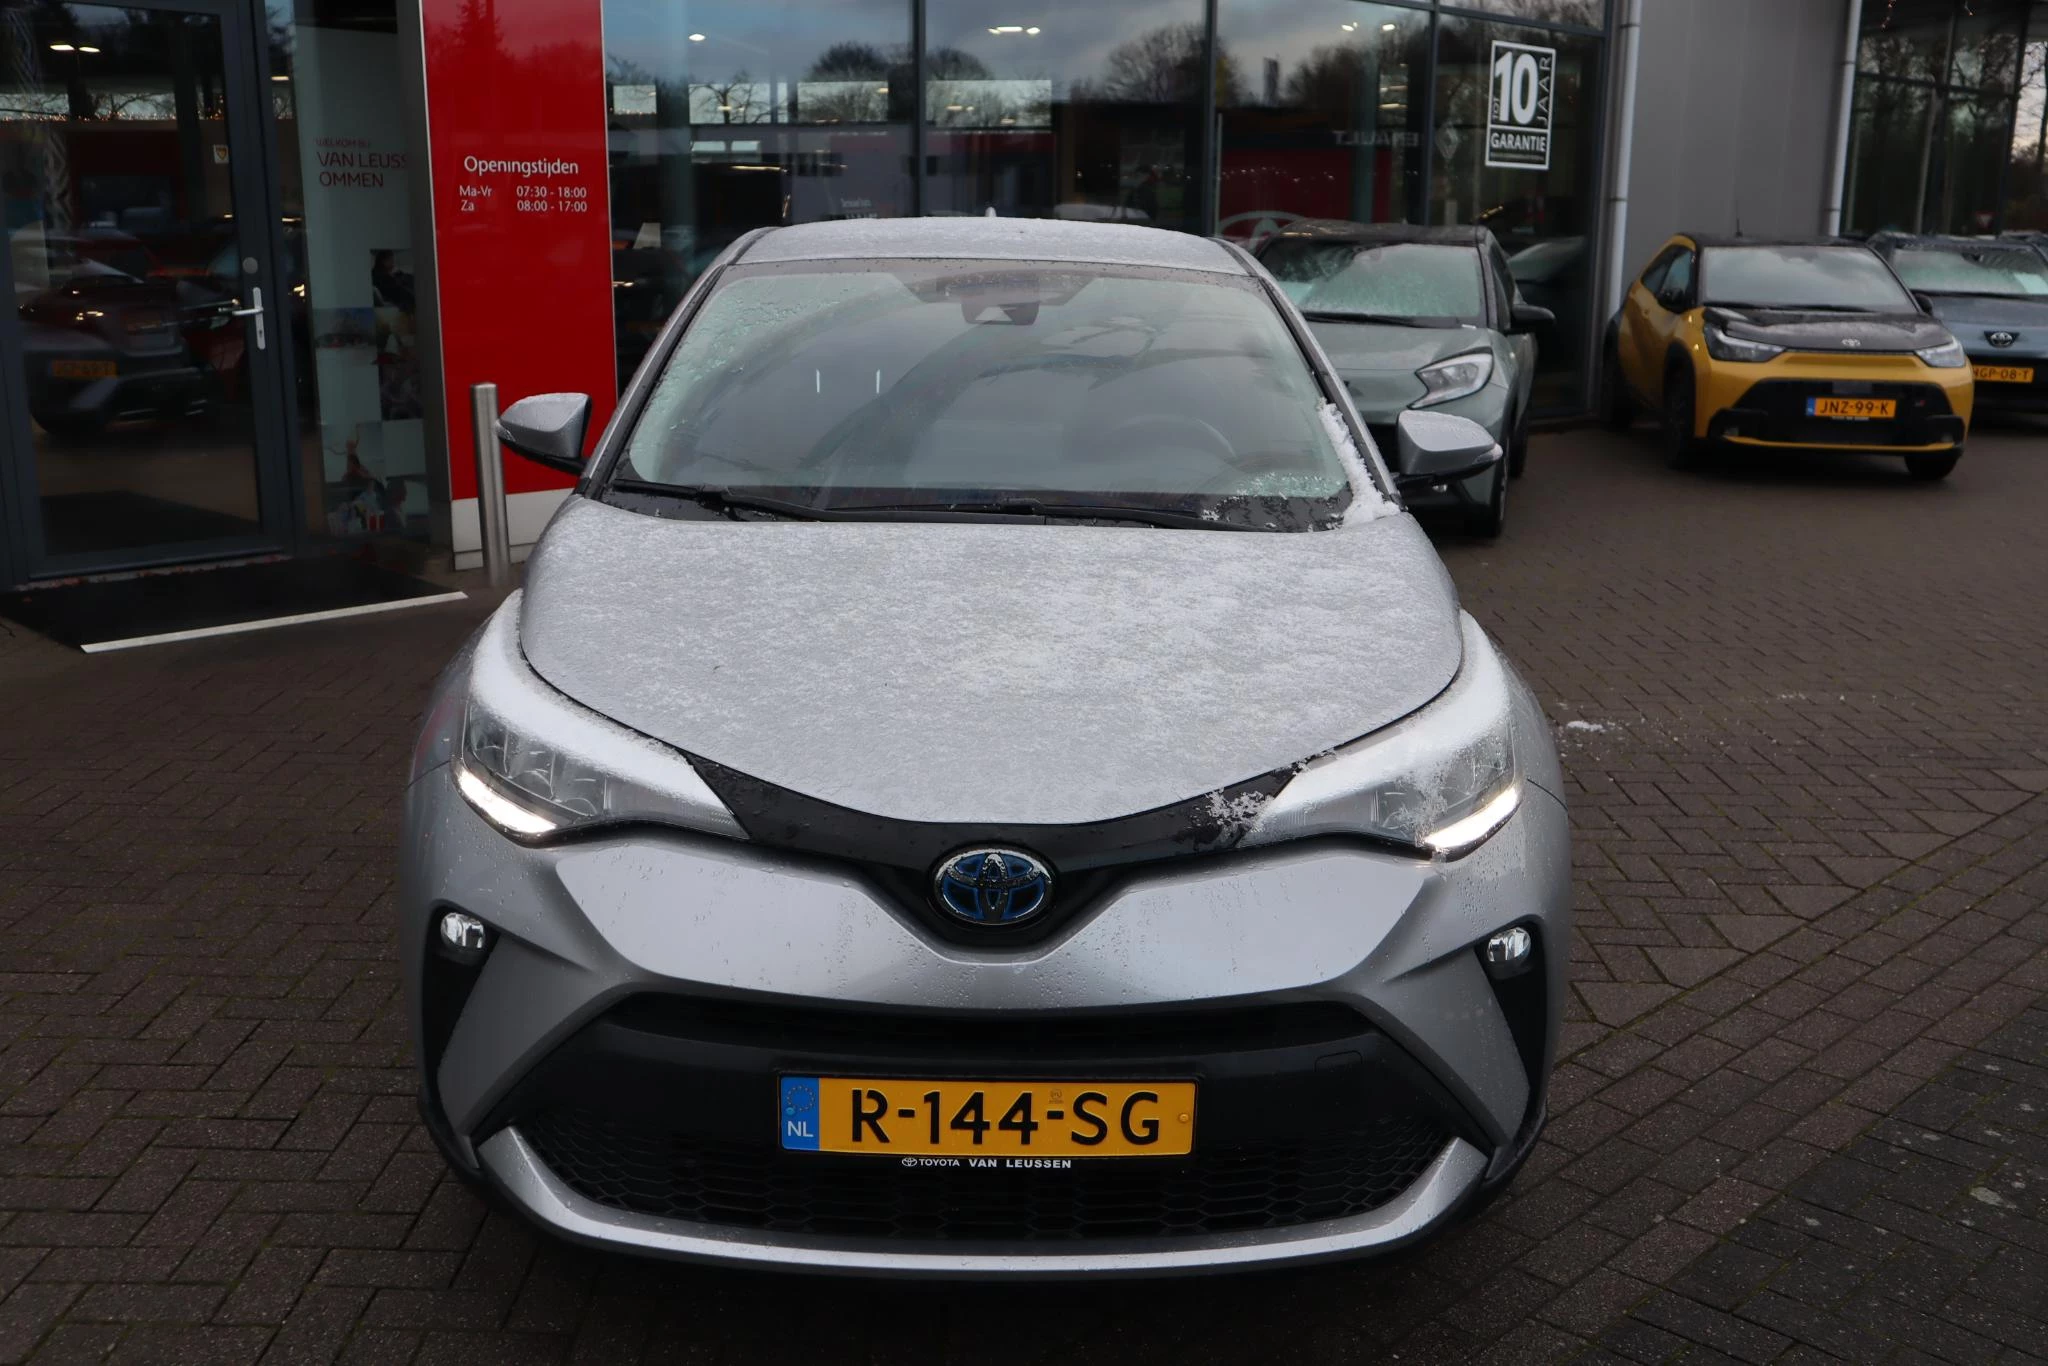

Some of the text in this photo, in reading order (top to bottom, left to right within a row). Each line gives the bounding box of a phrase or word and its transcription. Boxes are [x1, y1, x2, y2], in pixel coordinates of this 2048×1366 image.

[1494, 51, 1538, 125] 10
[1537, 57, 1551, 125] JAAR
[1490, 132, 1546, 152] GARANTIE
[317, 151, 353, 168] VAN
[463, 155, 580, 179] Openingstijden
[319, 171, 384, 188] OMMEN
[459, 185, 493, 197] Ma-Vr
[516, 185, 547, 197] 07:30
[558, 187, 587, 198] 18:00
[460, 200, 475, 212] Za
[517, 200, 548, 212] 08:00
[558, 201, 588, 212] 17:00
[1820, 400, 1889, 415] JNZ-99-K
[851, 1087, 1160, 1146] R-144-SG
[787, 1120, 814, 1138] NL
[918, 1158, 1073, 1169] TOYOTA VAN LEUSSEN
